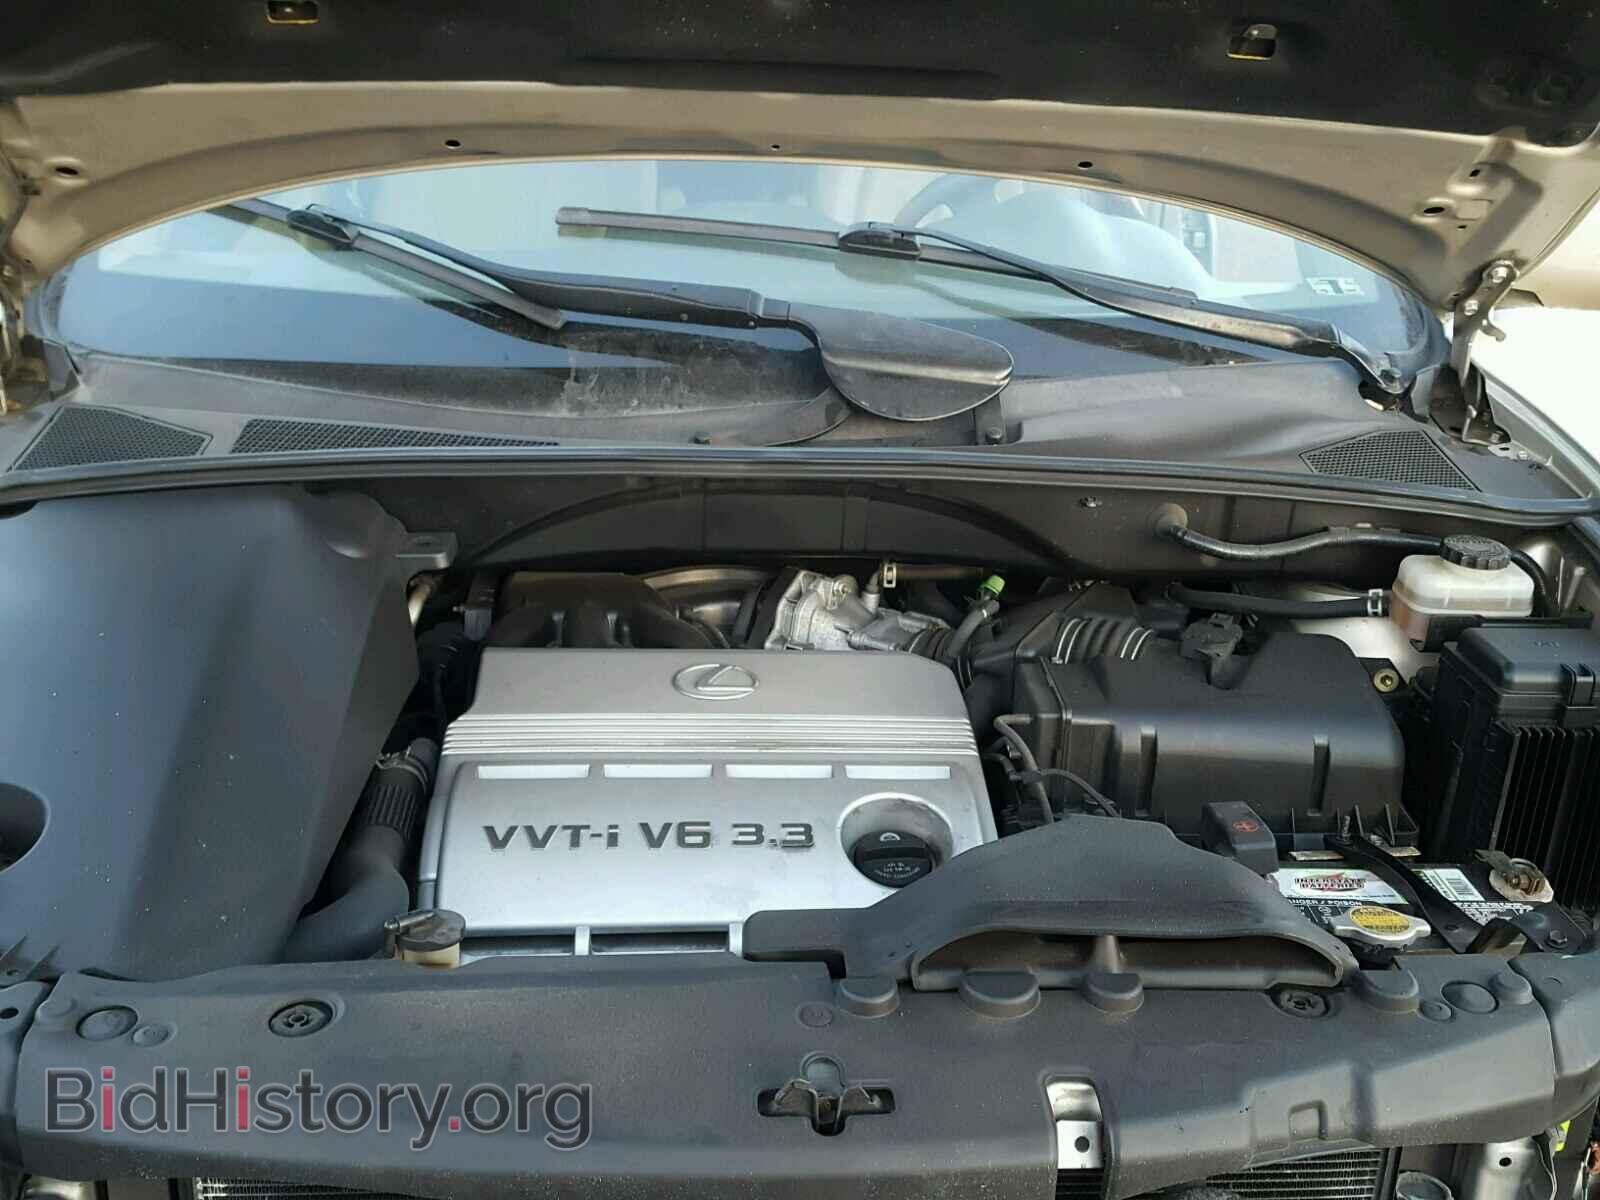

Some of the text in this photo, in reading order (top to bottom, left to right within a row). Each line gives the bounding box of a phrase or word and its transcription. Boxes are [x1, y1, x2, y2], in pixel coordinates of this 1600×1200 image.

[483, 821, 815, 849] VVT-i V6 3.3
